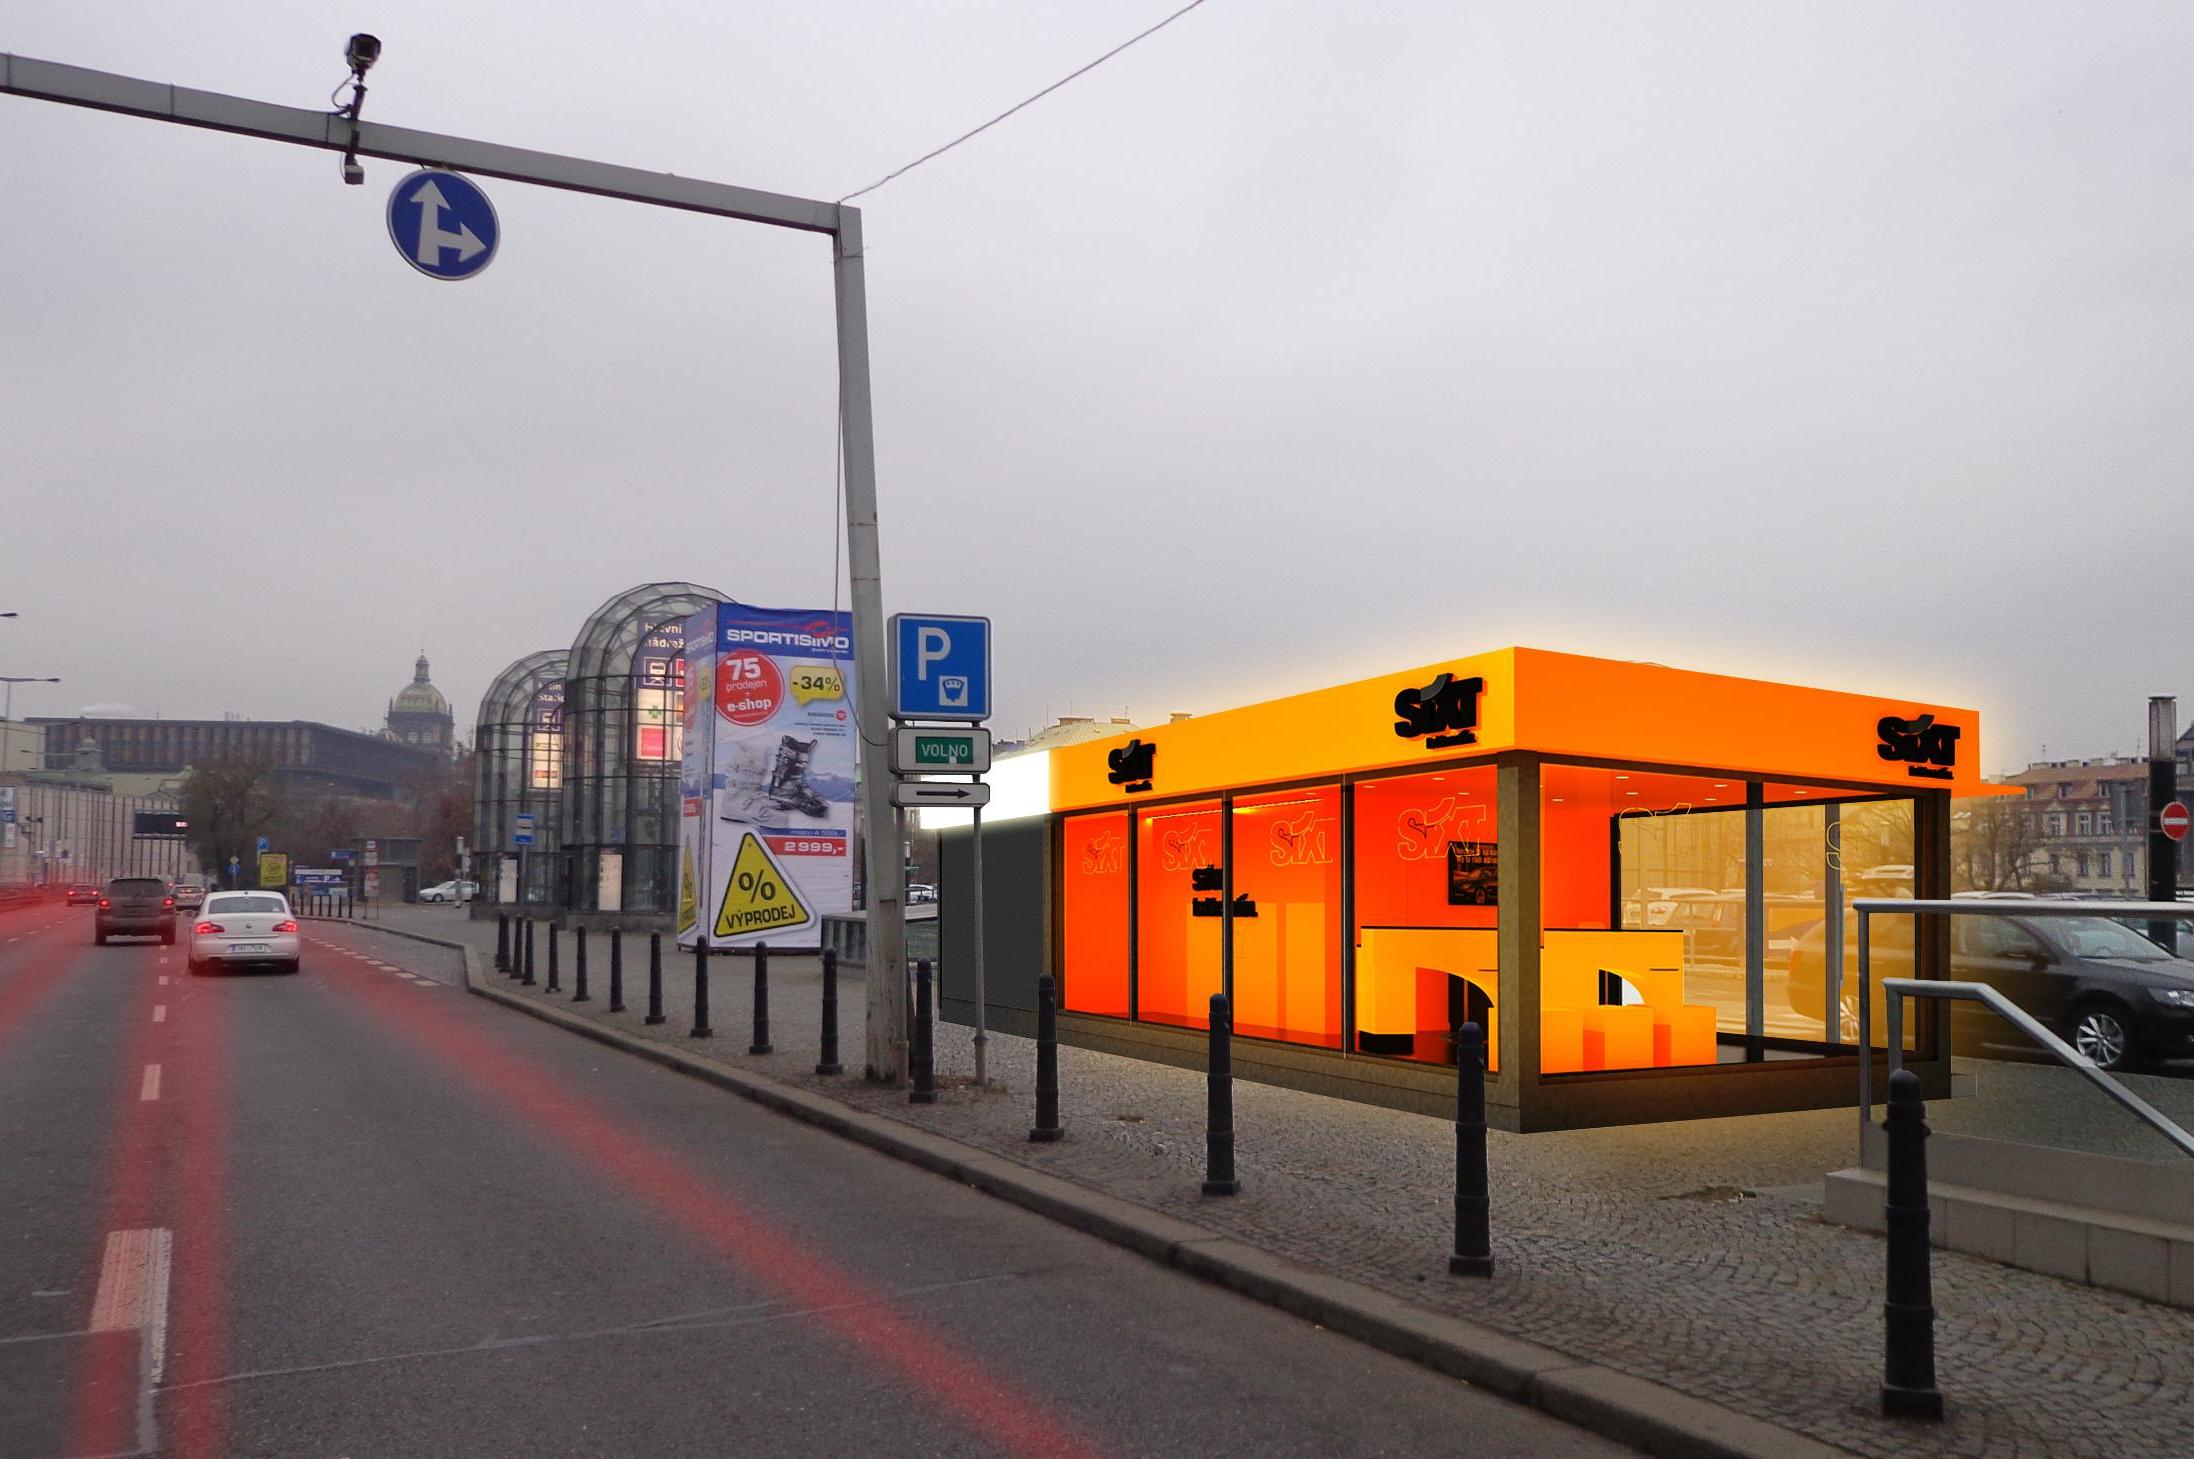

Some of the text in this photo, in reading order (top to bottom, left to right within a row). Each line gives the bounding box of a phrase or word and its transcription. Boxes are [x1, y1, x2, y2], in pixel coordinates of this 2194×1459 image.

[727, 629, 849, 649] SPORTISIMO
[918, 627, 951, 681] P
[726, 657, 762, 680] 75
[726, 679, 768, 693] prodejen
[727, 698, 772, 712] e-shop
[921, 743, 968, 756] VOLNO
[726, 904, 796, 929] VÝPRODEJ
